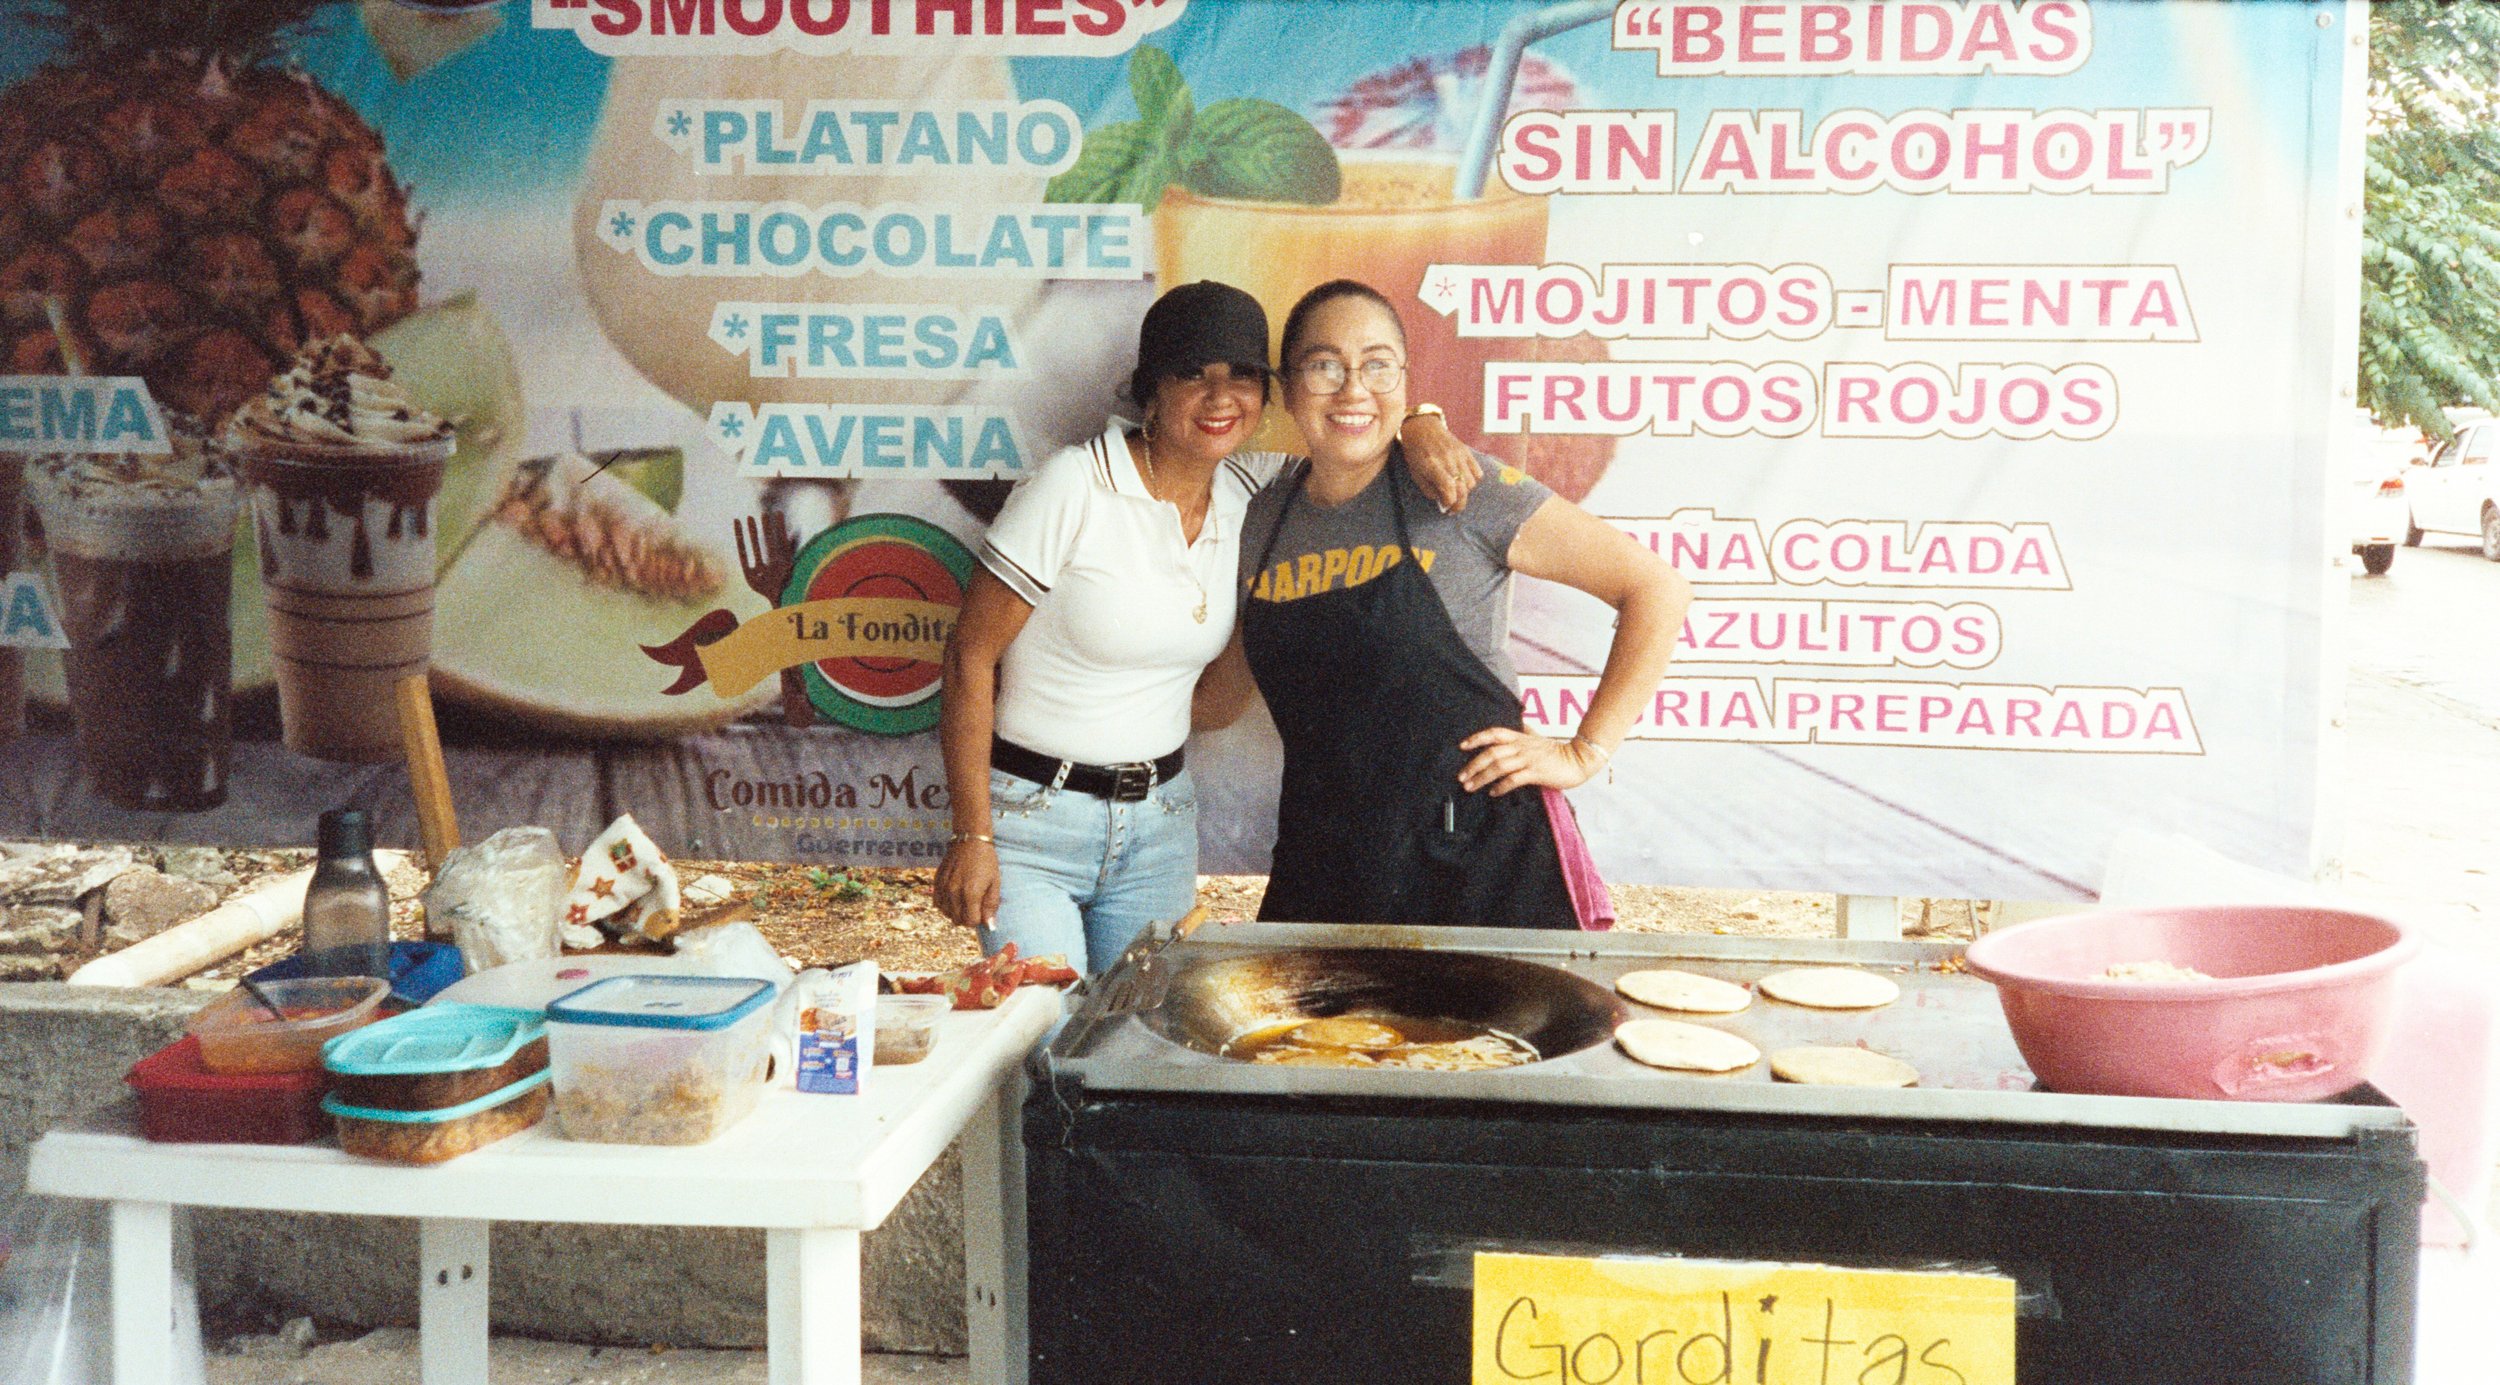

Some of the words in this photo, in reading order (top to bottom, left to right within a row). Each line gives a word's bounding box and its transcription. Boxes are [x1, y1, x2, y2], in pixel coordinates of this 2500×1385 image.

[551, 0, 1165, 37] SMOOTHIES
[1512, 122, 1660, 183] SIN
[1700, 122, 2197, 183] ALCOHOL”
[1898, 278, 2180, 329] MENTA
[1496, 374, 1803, 425] FRUTOS
[1836, 376, 2104, 428] ROJOS
[1624, 521, 1756, 570] IÑA
[1783, 533, 2052, 577] COLADA
[787, 612, 829, 641] La
[1521, 687, 1759, 729] ANRIA
[1787, 689, 2184, 741] PREPARADA
[705, 768, 857, 811] Comida
[1495, 1291, 1968, 1385] Gorditas
